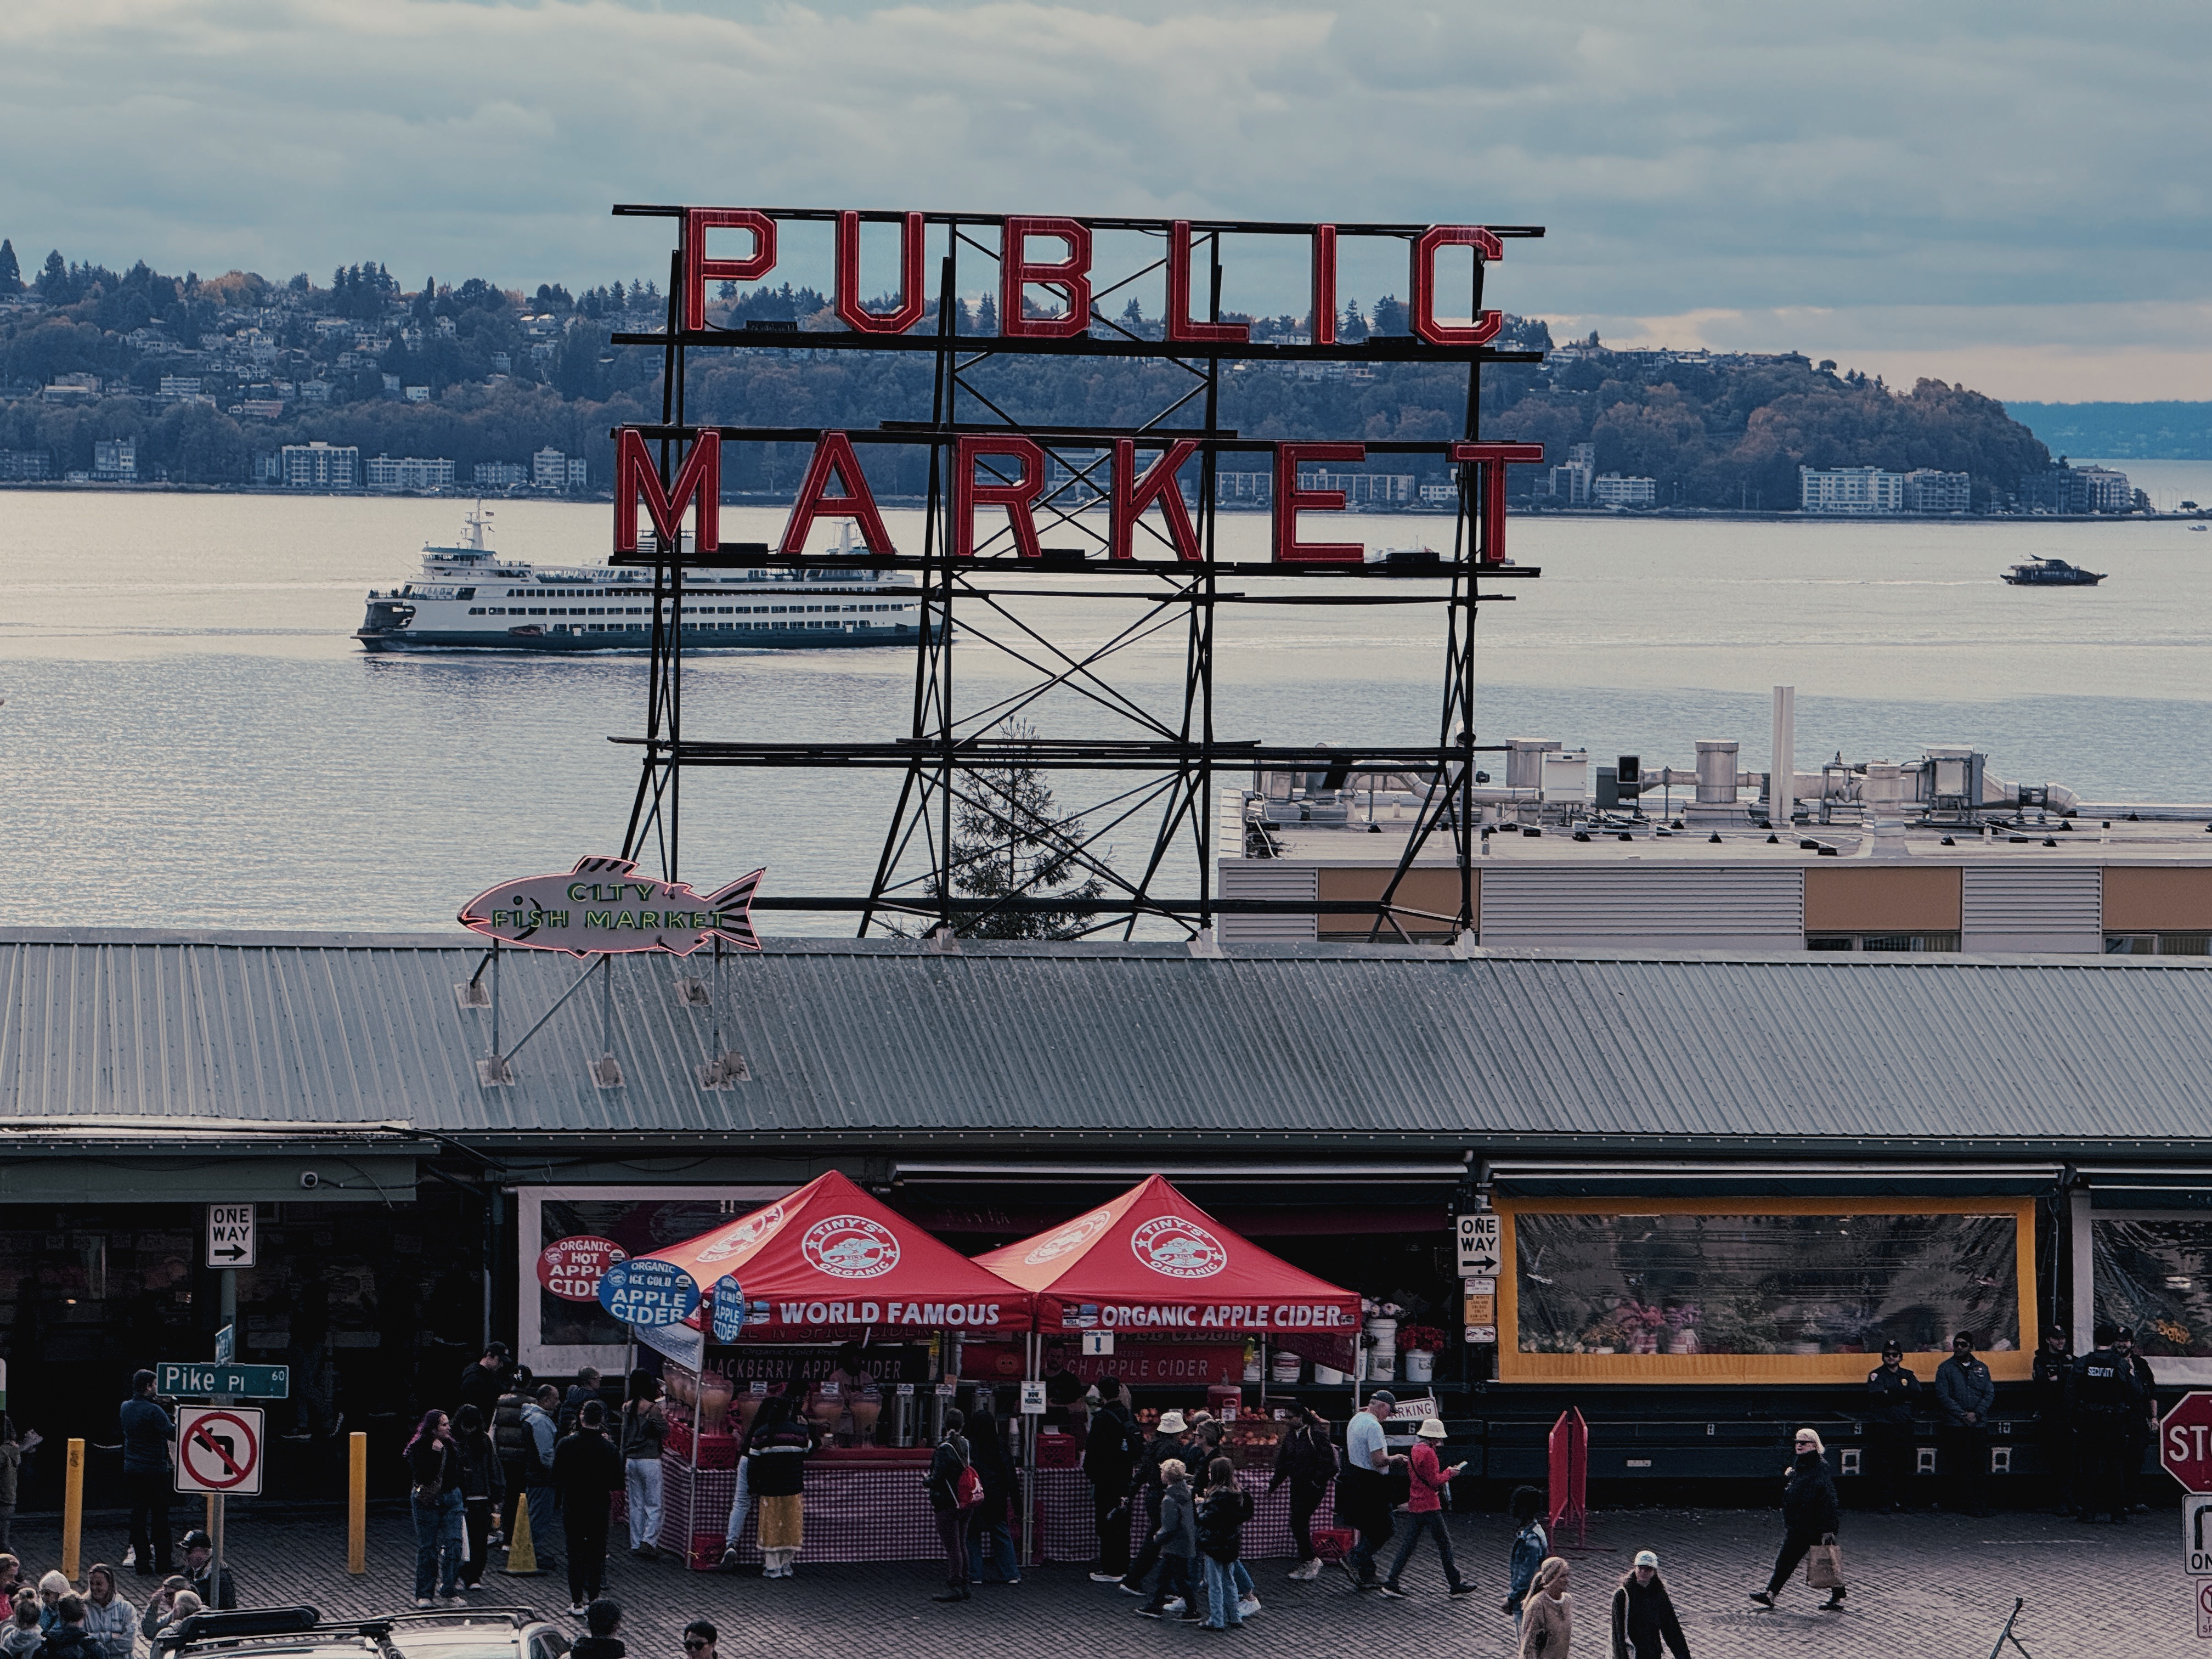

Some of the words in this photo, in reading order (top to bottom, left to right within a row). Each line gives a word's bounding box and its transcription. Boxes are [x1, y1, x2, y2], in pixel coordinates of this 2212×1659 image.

[680, 207, 1503, 346] PUBLIC
[614, 427, 1544, 563] MARKET
[567, 882, 656, 901] CITY
[492, 909, 569, 929] FISH
[585, 910, 729, 929] MARKET
[213, 1209, 249, 1224] ONE
[213, 1226, 250, 1242] WAY
[1462, 1219, 1496, 1234] ONE
[559, 1240, 612, 1252] ORGANIC
[1461, 1236, 1497, 1251] WAY
[571, 1252, 600, 1265] HOT
[631, 1261, 675, 1274] ORGANIC
[819, 1261, 890, 1277] ORGANIC
[1150, 1260, 1219, 1276] ORGANIC
[549, 1278, 601, 1297] CIDE
[628, 1274, 645, 1285] ICE
[646, 1275, 672, 1288] COLD
[611, 1288, 687, 1308] APPLE
[610, 1303, 686, 1325] CIDER
[714, 1305, 740, 1325] APPLE
[780, 1302, 884, 1324] WORLD
[887, 1302, 1000, 1325] FAMOUS
[1102, 1306, 1197, 1327] ORGANIC
[1200, 1305, 1269, 1327] APPLE
[1273, 1305, 1341, 1327] CIDER
[713, 1320, 739, 1342] CIDER
[742, 1347, 785, 1356] Organic
[272, 1370, 285, 1381] 60
[703, 1358, 794, 1379] ACKBERRY
[861, 1361, 901, 1379] IDER
[1095, 1359, 1149, 1376] APPLE
[1158, 1359, 1209, 1376] CIDER
[166, 1367, 215, 1391] Pike
[228, 1375, 245, 1392] Pl
[1390, 1403, 1432, 1419] RKING
[2169, 1425, 2212, 1462] ST
